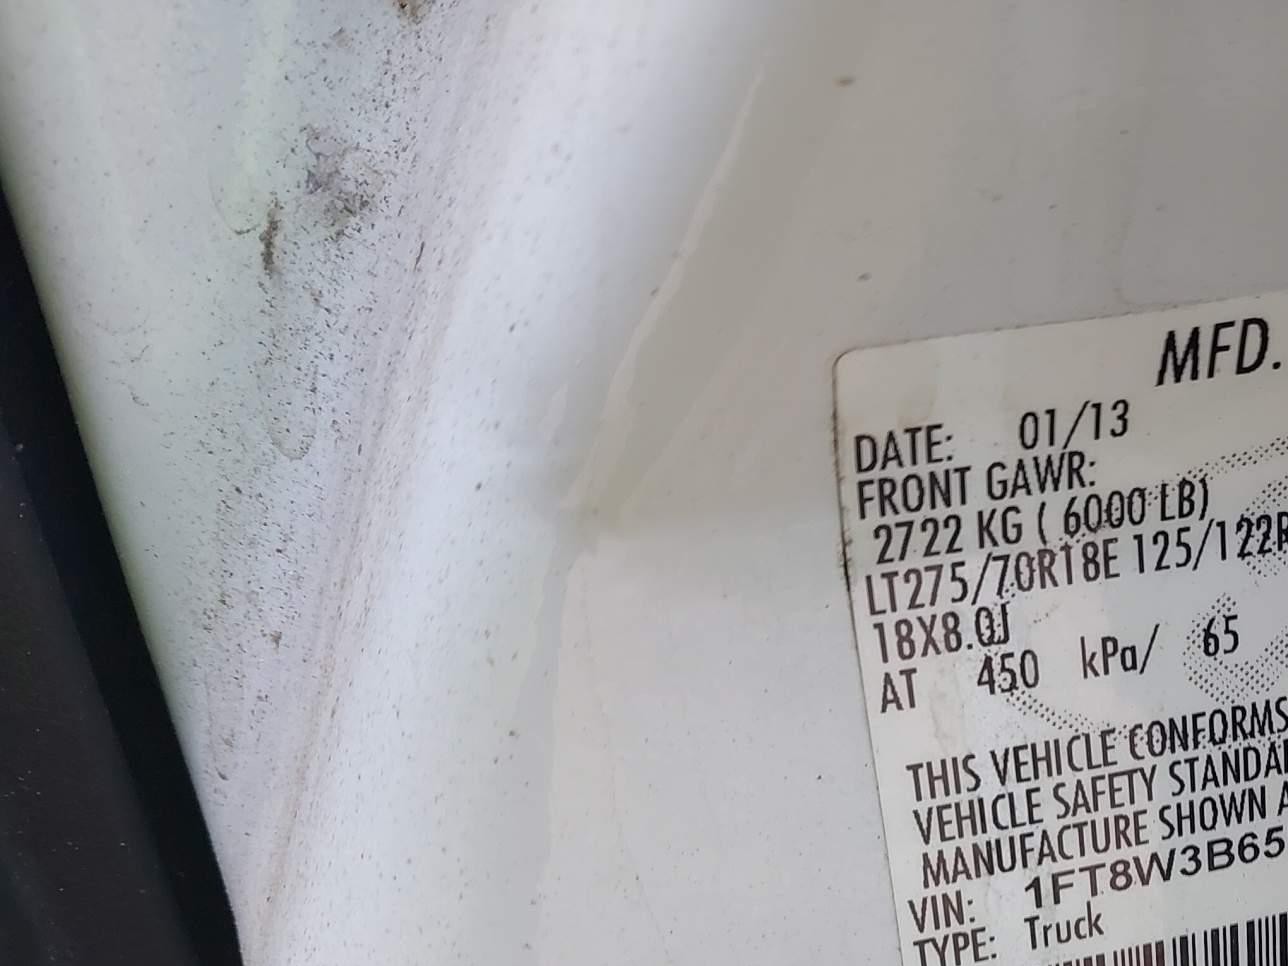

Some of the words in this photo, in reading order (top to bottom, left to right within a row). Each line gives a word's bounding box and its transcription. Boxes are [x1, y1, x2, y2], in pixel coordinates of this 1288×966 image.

[1155, 316, 1282, 387] MFD.
[854, 423, 954, 473] DATE:
[1018, 399, 1131, 451] 01/13
[857, 467, 971, 519] FRONT
[986, 450, 1097, 500] GAWR:
[872, 522, 964, 565] 2722
[976, 508, 1024, 550] KG
[1158, 477, 1210, 521] LB)
[866, 538, 1121, 616] LT275/70R18E
[873, 602, 1010, 664] 18X8.0J
[880, 670, 918, 713] AT
[976, 651, 1040, 696] 450
[1080, 623, 1160, 680] kPa/
[1202, 614, 1240, 657] 65
[906, 754, 981, 802] THIS
[990, 728, 1116, 789] VEHICLE
[1128, 696, 1288, 761] CONFORMS
[913, 786, 1045, 846] VEHICLE
[1055, 764, 1158, 820] SAFETY
[922, 809, 1149, 890] MANUFACTURE
[1160, 784, 1267, 841] SHOWN
[907, 890, 976, 934] VIN:
[1024, 901, 1105, 950] Truck
